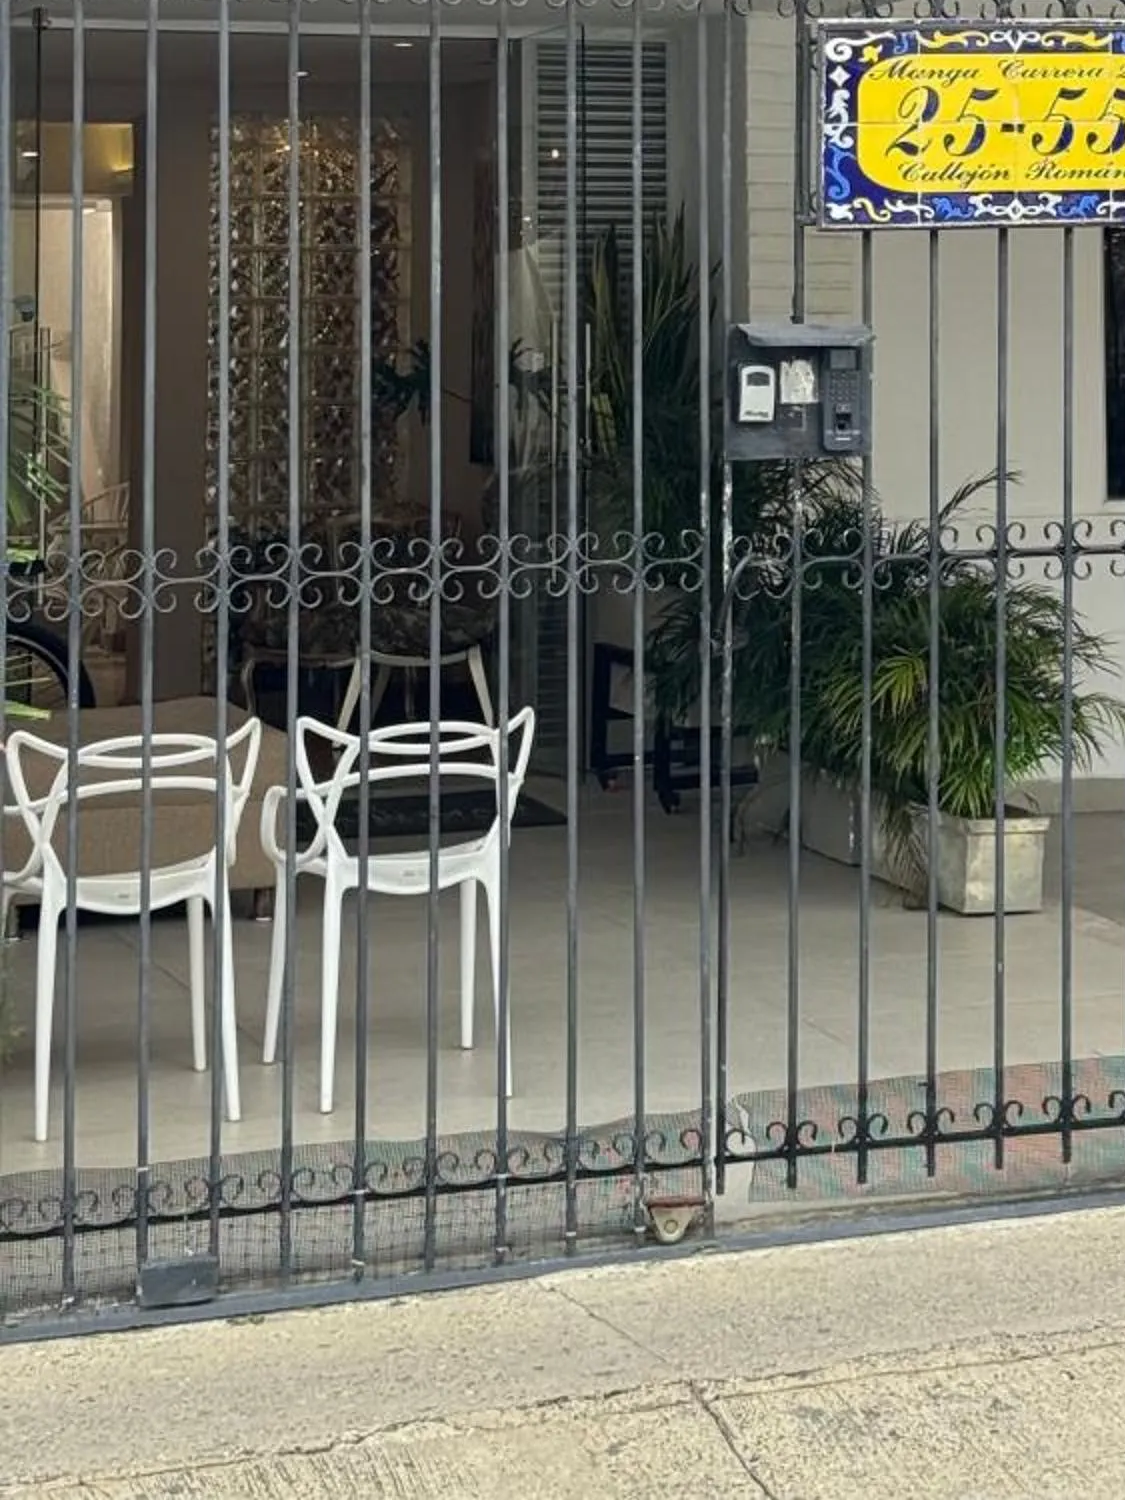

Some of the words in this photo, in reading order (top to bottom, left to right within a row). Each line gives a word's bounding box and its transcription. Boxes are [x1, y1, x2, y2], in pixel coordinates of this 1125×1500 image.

[869, 59, 980, 87] Manga
[997, 59, 1104, 83] Carrera
[897, 161, 1010, 189] Callejón
